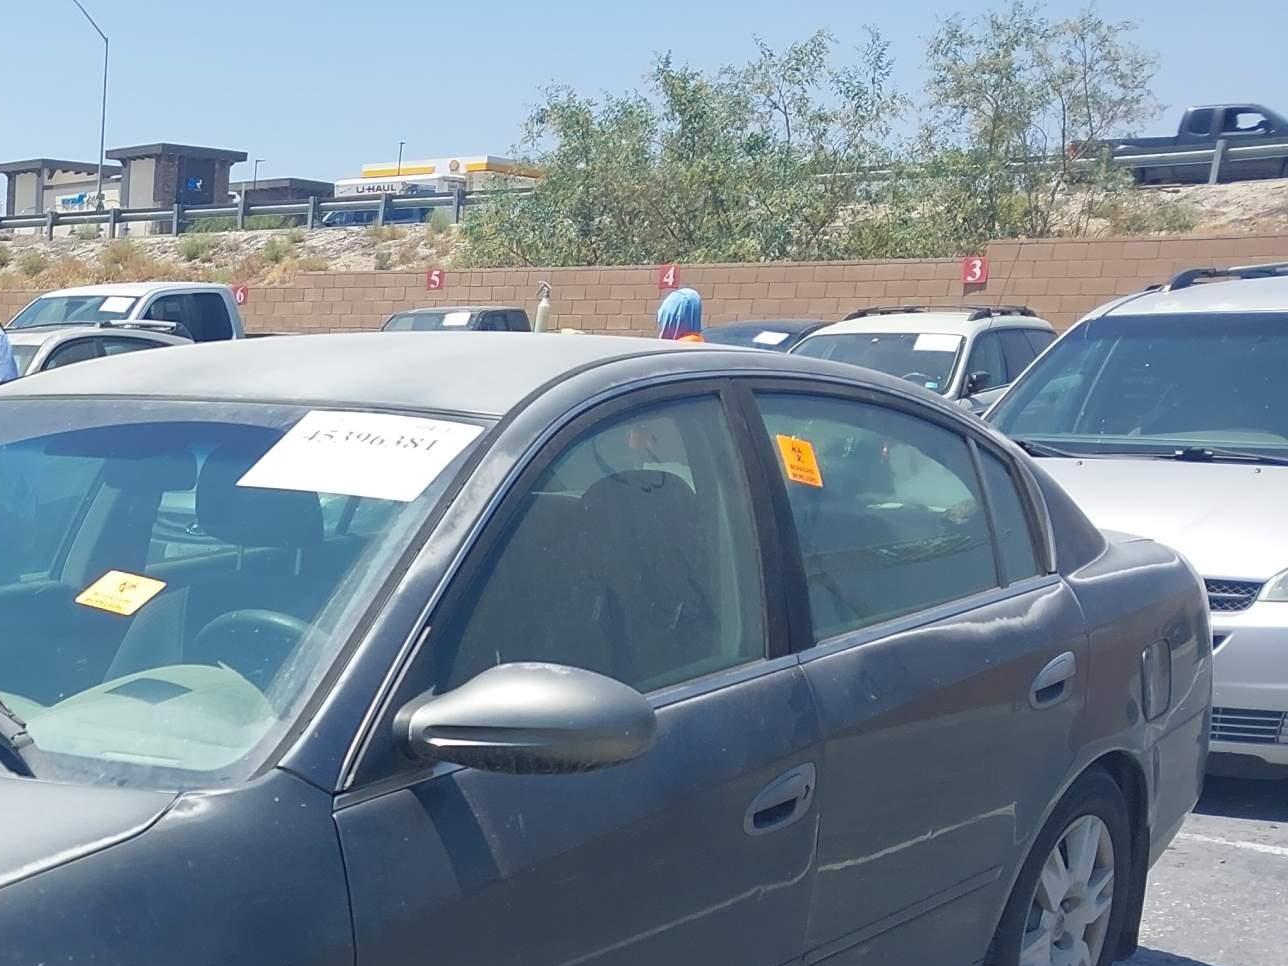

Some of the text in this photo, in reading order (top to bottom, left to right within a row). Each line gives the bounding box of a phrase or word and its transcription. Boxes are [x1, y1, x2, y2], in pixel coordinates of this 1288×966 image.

[429, 270, 441, 288] 5
[663, 266, 675, 286] 4
[967, 259, 982, 281] 3
[236, 287, 245, 303] 6
